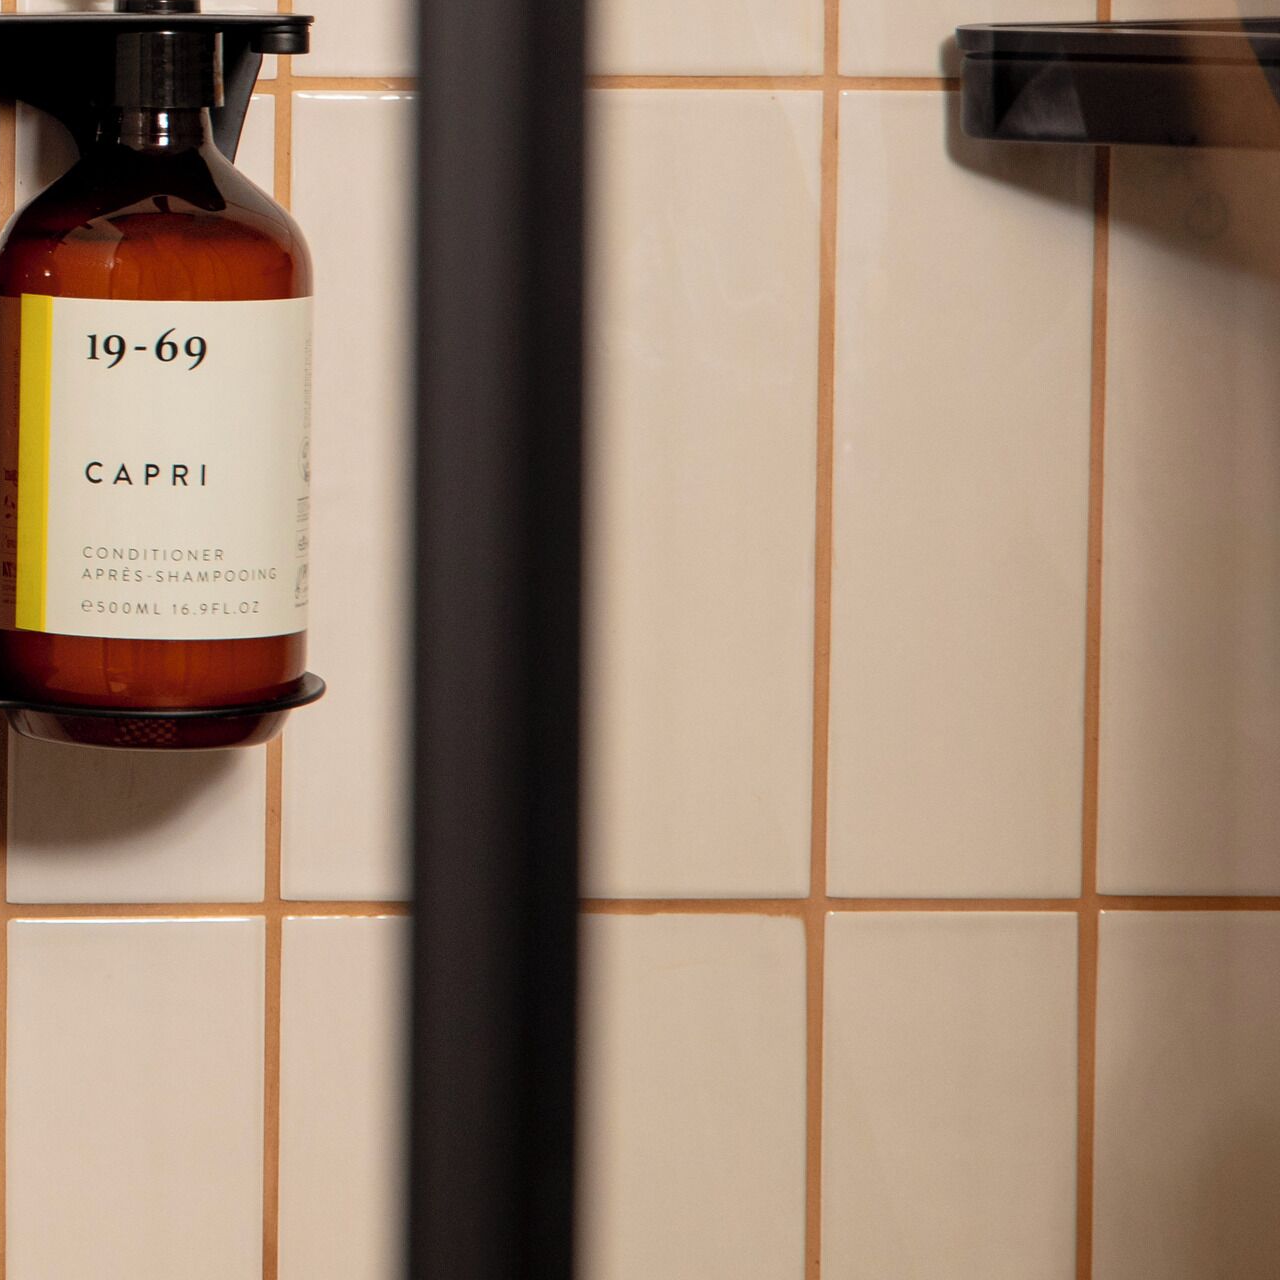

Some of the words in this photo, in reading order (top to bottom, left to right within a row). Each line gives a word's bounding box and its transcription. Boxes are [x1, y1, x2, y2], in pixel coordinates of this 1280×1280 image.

[85, 327, 209, 372] 19-69
[83, 460, 207, 487] CAPRI
[81, 545, 225, 562] CONDITIONER
[80, 566, 278, 583] APRÈS-SHAMPOOING
